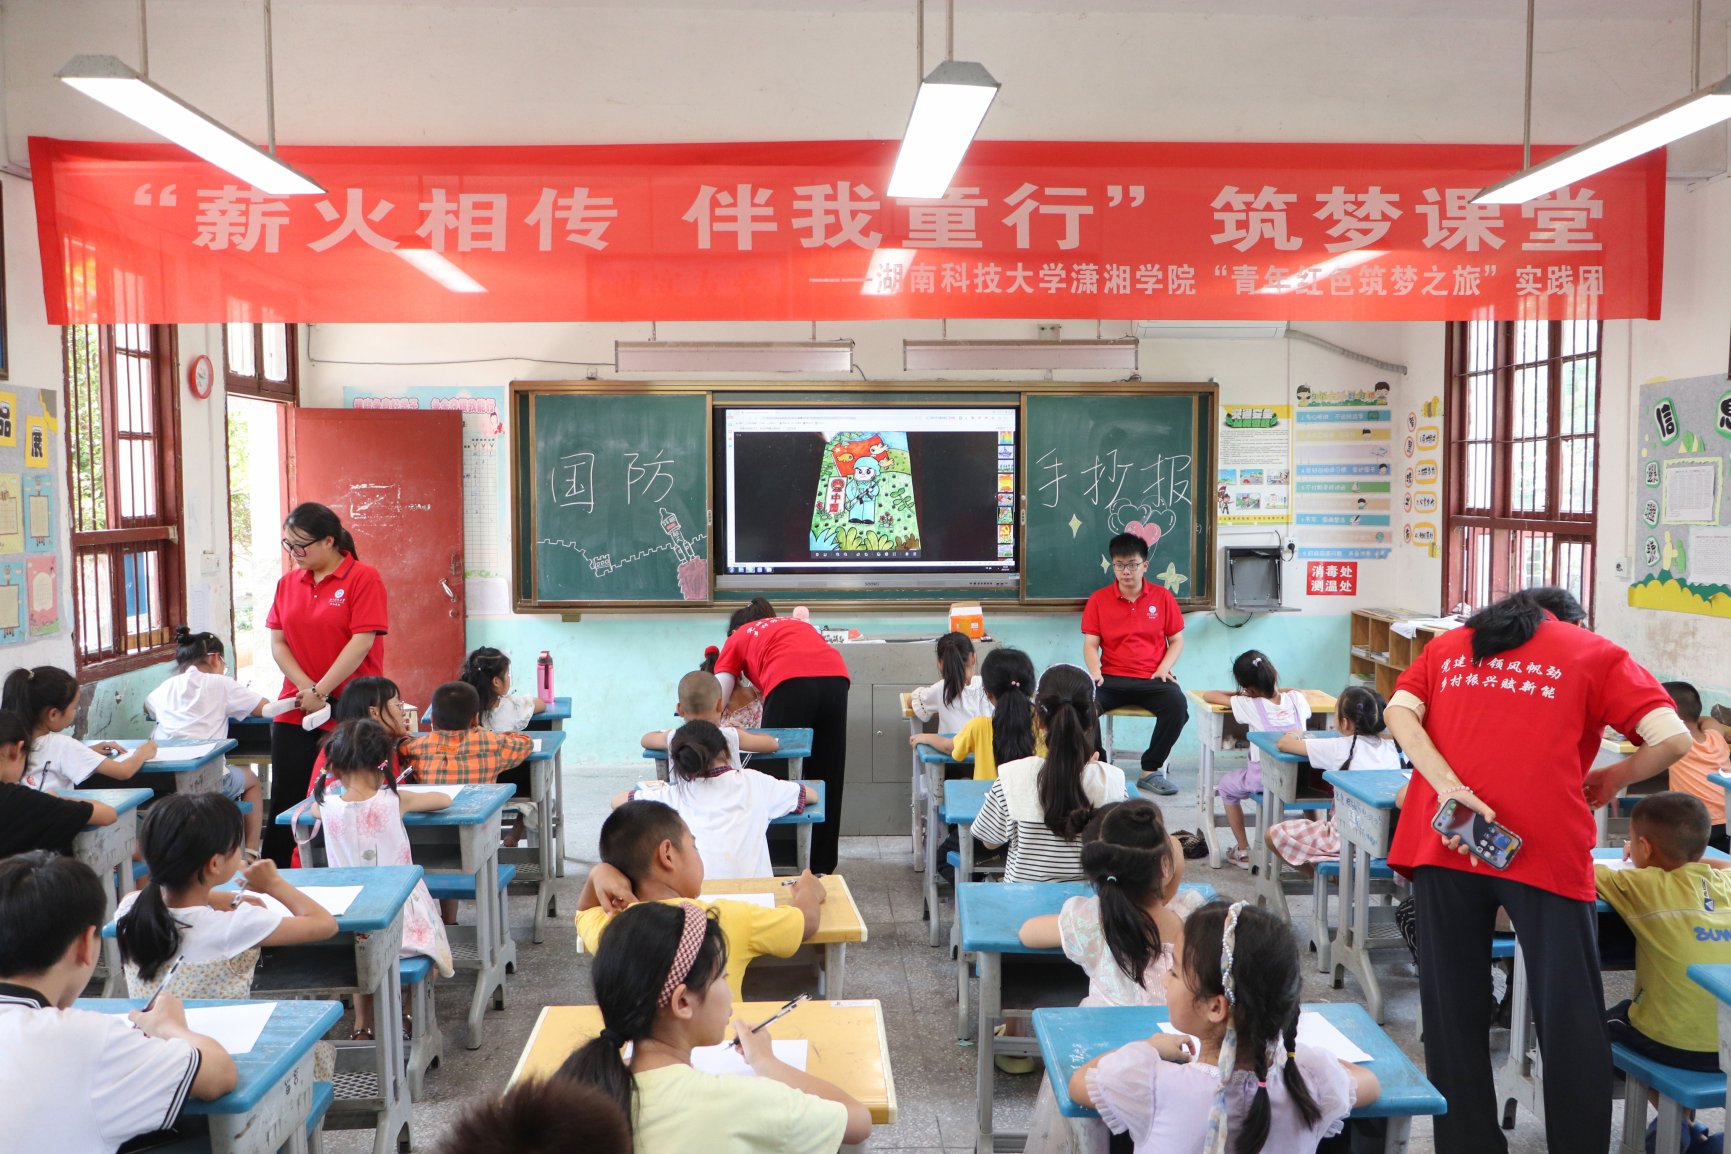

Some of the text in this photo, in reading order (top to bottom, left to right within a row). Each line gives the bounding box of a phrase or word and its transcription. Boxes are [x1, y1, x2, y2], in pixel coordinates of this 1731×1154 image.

[134, 181, 1603, 253] “薪火相传 伴我童行” 筑梦课堂
[1215, 264, 1497, 296] “青年红色筑梦之旅”
[1515, 264, 1604, 296] 实践团
[551, 449, 675, 514] 国防
[1036, 448, 1192, 510] 手抄报
[1311, 565, 1353, 578] 消毒处
[1311, 580, 1352, 593] 测温处
[1440, 672, 1556, 699] 乡村振兴赋新能
